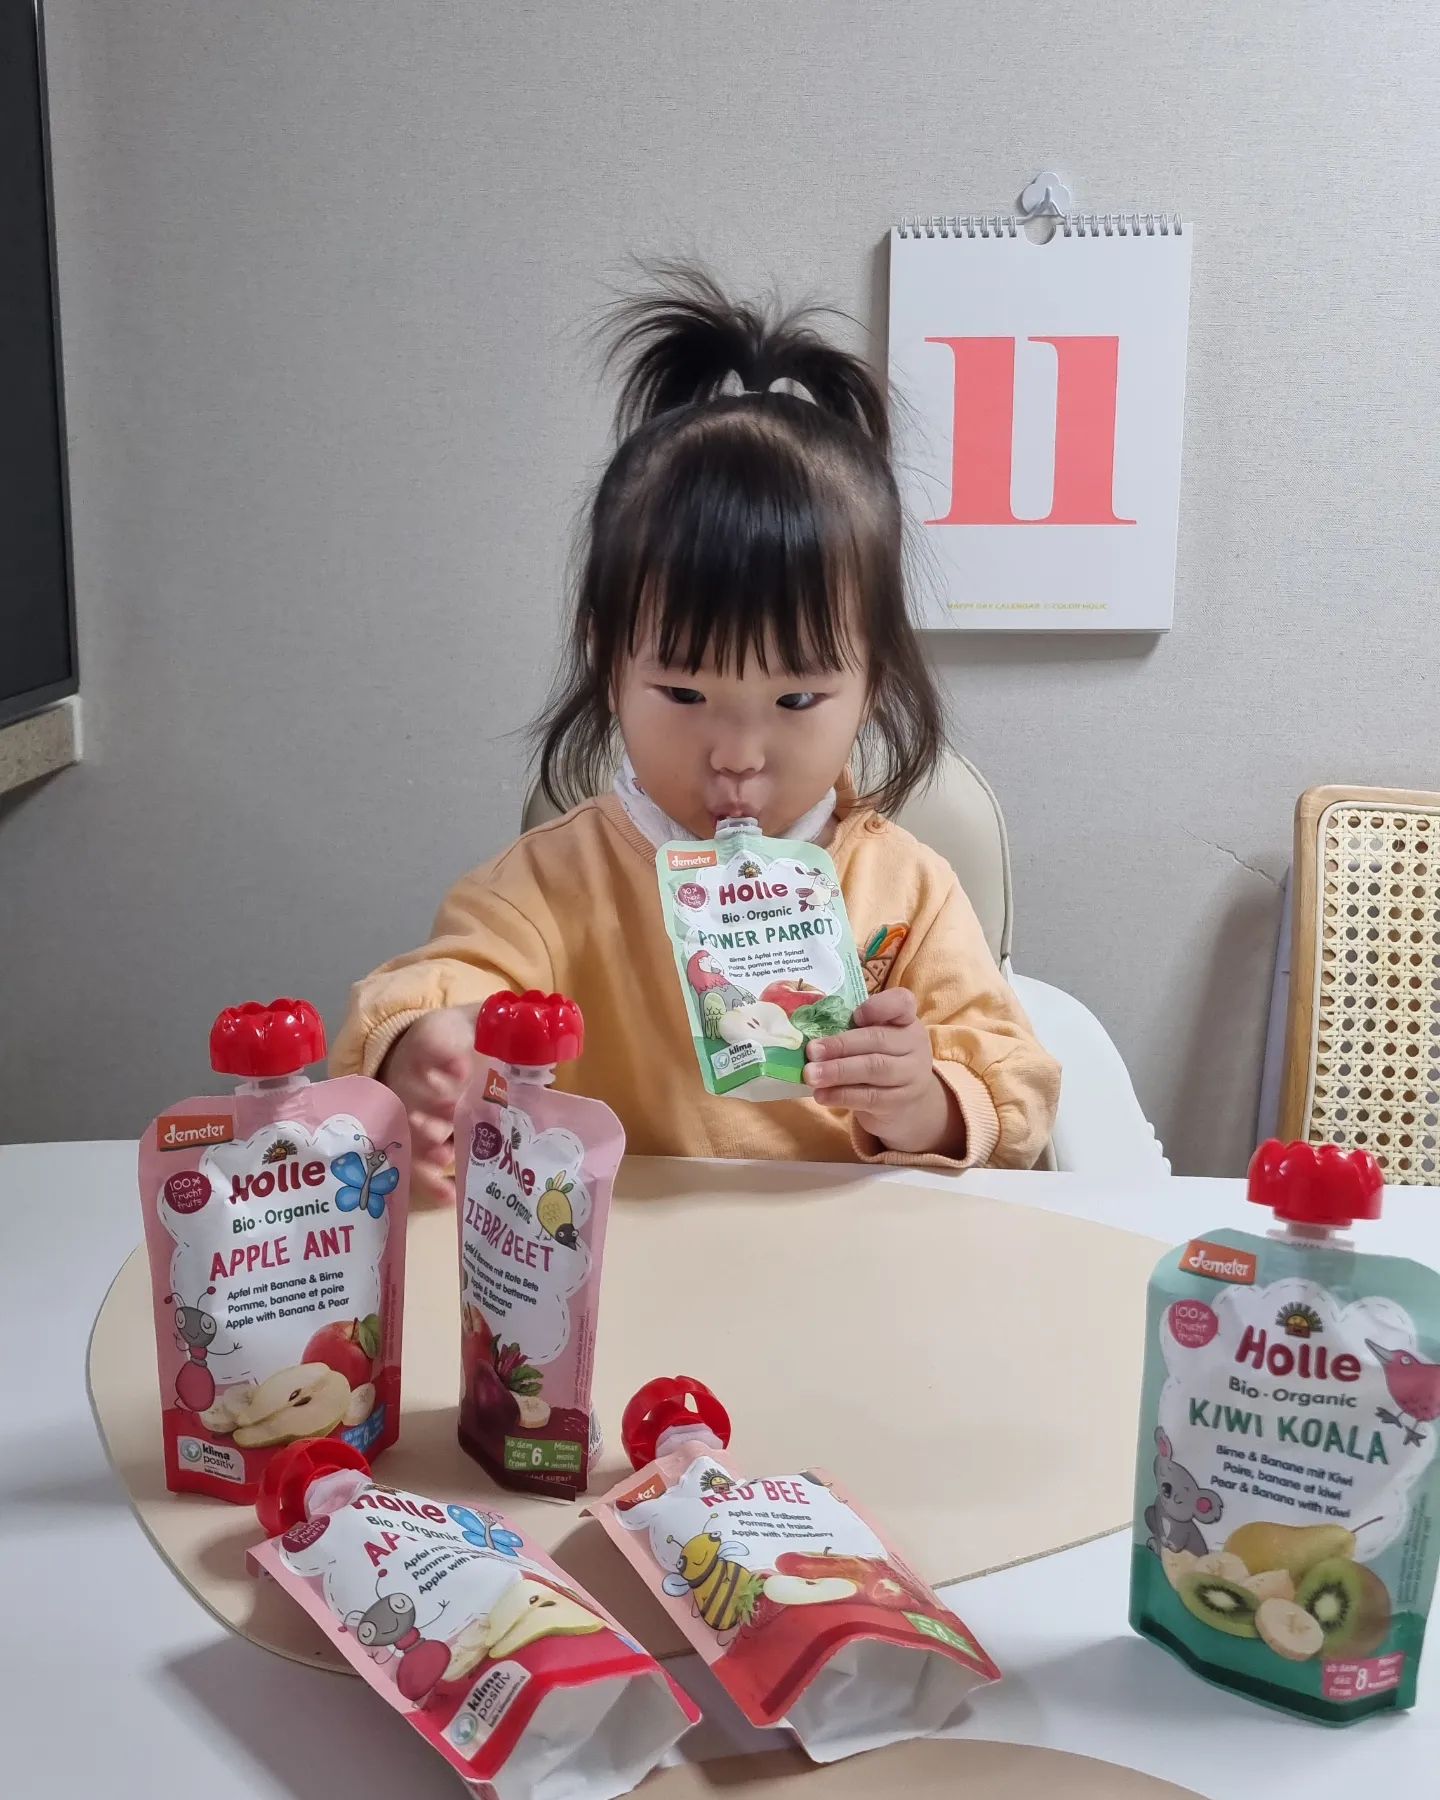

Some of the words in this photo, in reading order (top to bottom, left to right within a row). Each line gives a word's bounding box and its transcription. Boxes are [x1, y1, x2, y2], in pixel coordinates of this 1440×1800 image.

[924, 336, 1137, 526] 11
[671, 854, 712, 867] demeter
[718, 880, 789, 906] Holle
[722, 911, 741, 924] Bio
[746, 905, 793, 922] Organic
[698, 930, 760, 950] POWER
[766, 918, 834, 944] PARROT
[748, 962, 773, 970] pomme
[782, 957, 810, 965] épinards
[754, 952, 771, 960] Apfel
[784, 949, 805, 957] Spinat
[752, 970, 771, 978] Apple
[787, 964, 813, 973] Spinach
[729, 1042, 752, 1056] klima
[164, 1123, 225, 1144] demeter
[169, 1176, 201, 1191] 100%
[172, 1186, 203, 1203] Frucht
[229, 1160, 326, 1205] Holle
[177, 1198, 203, 1209] fruits
[485, 1181, 501, 1200] Bio
[506, 1193, 534, 1225] Organic
[232, 1217, 256, 1234] Bio
[265, 1199, 330, 1226] Organic
[465, 1197, 508, 1249] ZEBRA
[501, 1229, 554, 1273] BEET
[209, 1235, 290, 1282] APPLE
[303, 1224, 355, 1262] ANT
[1189, 1250, 1250, 1276] demeter
[227, 1285, 251, 1302] Apfel
[253, 1283, 269, 1296] mit
[270, 1276, 307, 1292] Banane
[308, 1273, 317, 1285] &
[319, 1268, 344, 1282] Birne
[494, 1267, 504, 1278] mit
[505, 1271, 522, 1285] Rote
[522, 1278, 539, 1292] Bete
[228, 1298, 269, 1314] Pomme,
[270, 1289, 307, 1306] banane
[308, 1287, 319, 1299] et
[320, 1283, 345, 1299] poire
[482, 1297, 506, 1317] Beetroot
[489, 1289, 513, 1309] Banana
[503, 1284, 537, 1305] betterave
[225, 1312, 254, 1330] Apple
[256, 1310, 277, 1323] with
[278, 1304, 316, 1319] Banana
[318, 1300, 326, 1311] &
[328, 1295, 350, 1310] Pear
[1175, 1304, 1209, 1321] 100%
[1234, 1324, 1362, 1383] Holle
[1228, 1375, 1260, 1399] Bio
[1272, 1387, 1358, 1409] Organic
[1188, 1397, 1264, 1437] KIWI
[1277, 1416, 1390, 1466] KOALA
[202, 1443, 231, 1460] klima
[203, 1455, 235, 1470] positiv
[1215, 1444, 1246, 1461] Birne
[1248, 1450, 1258, 1463] &
[1260, 1454, 1305, 1475] Banane
[1306, 1465, 1326, 1481] mit
[1327, 1470, 1354, 1487] Kiwi
[762, 1479, 811, 1505] BEE
[1223, 1462, 1255, 1480] Poire,
[1257, 1470, 1301, 1490] banane
[1303, 1482, 1317, 1495] et
[1318, 1484, 1343, 1501] kiwi
[1210, 1475, 1238, 1493] Pear
[1239, 1482, 1250, 1495] &
[1251, 1485, 1295, 1507] Banana
[1298, 1497, 1323, 1514] with
[1324, 1502, 1351, 1519] Kiwi
[728, 1509, 754, 1519] Apfel
[754, 1511, 770, 1519] mit
[770, 1511, 812, 1521] Erdbeere
[738, 1519, 775, 1528] Pomme
[776, 1521, 786, 1529] et
[786, 1521, 814, 1530] fraise
[366, 1514, 394, 1529] Bio
[401, 1520, 463, 1543] Organic
[731, 1529, 760, 1539] Apple
[761, 1530, 780, 1538] with
[781, 1530, 835, 1539] Strawberry
[403, 1550, 430, 1571] Apfel
[411, 1553, 455, 1581] Pomme,
[418, 1570, 448, 1595] Apple
[448, 1555, 470, 1571] with
[467, 1671, 503, 1712] klima
[478, 1672, 512, 1721] positiv
